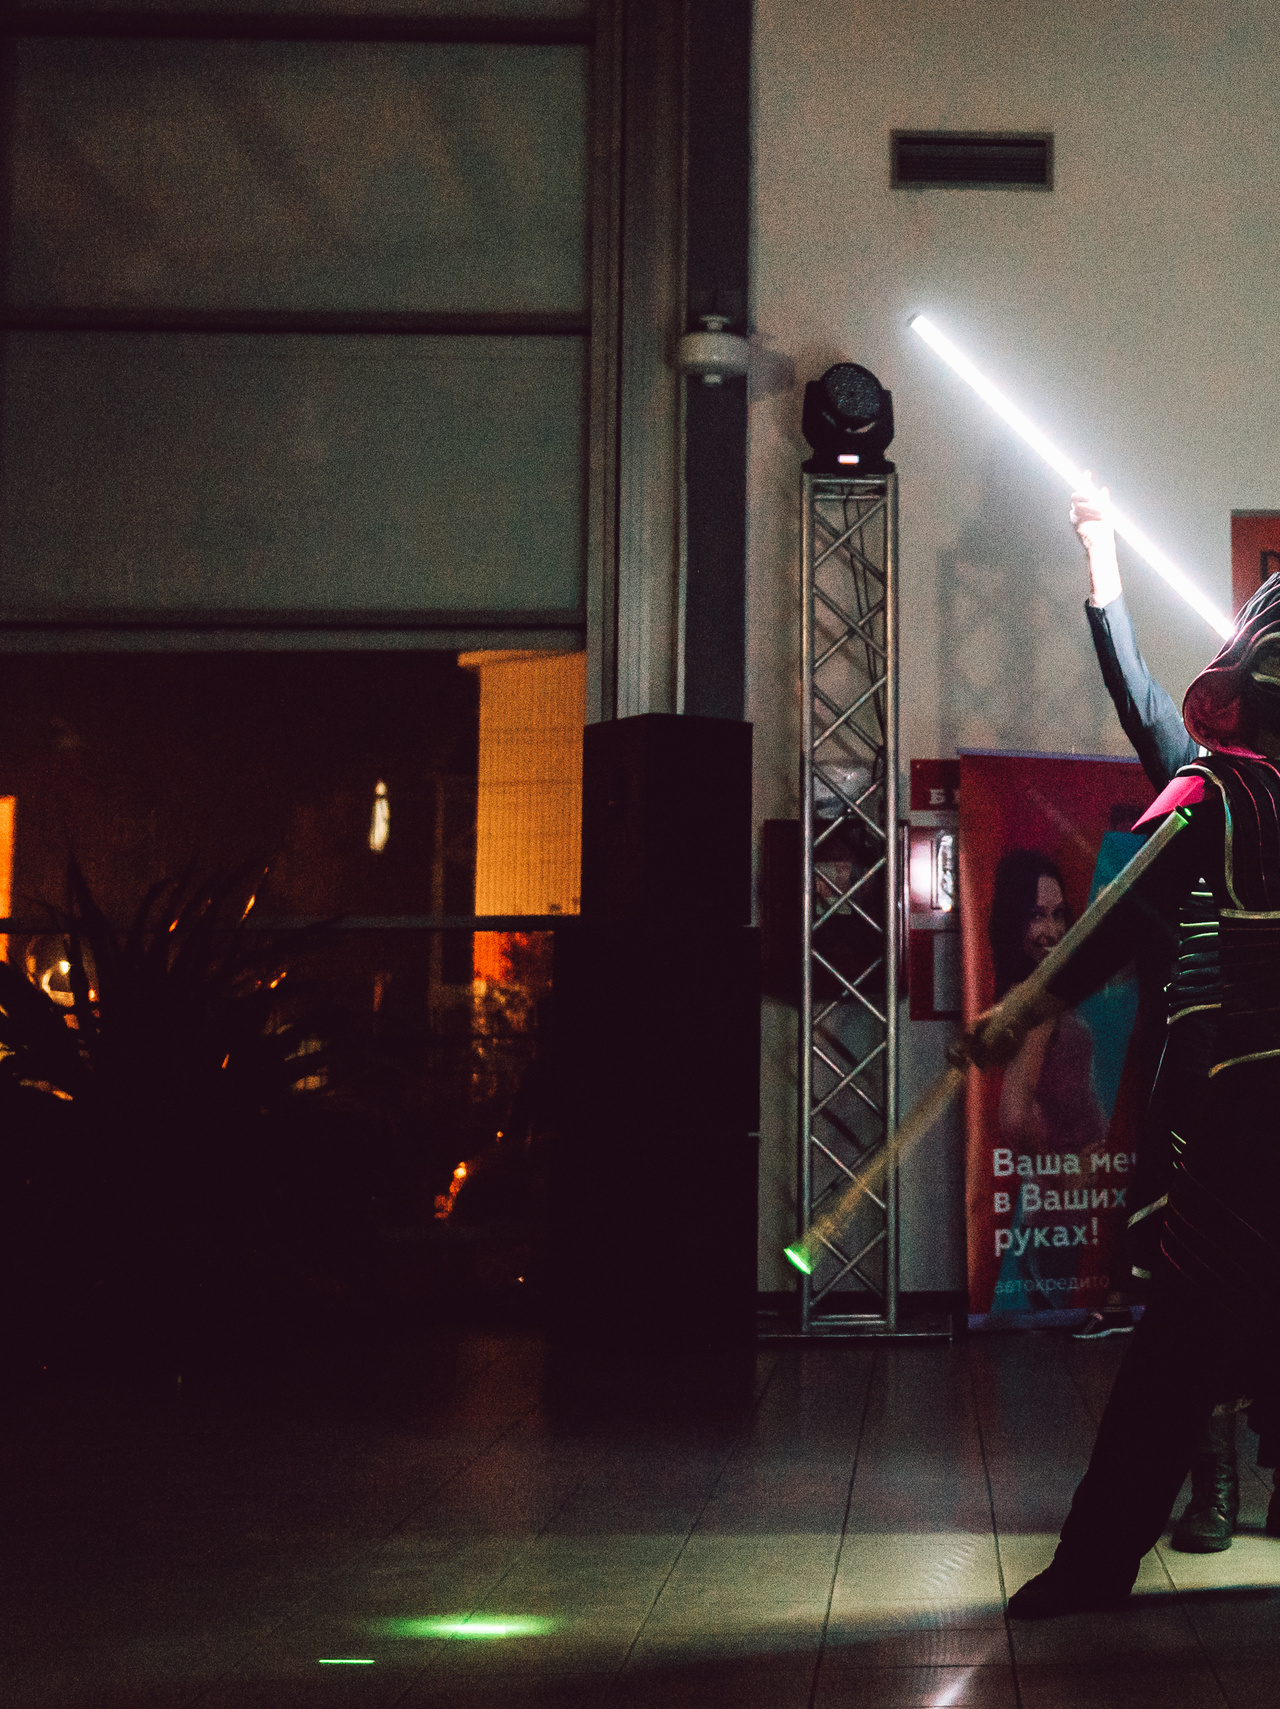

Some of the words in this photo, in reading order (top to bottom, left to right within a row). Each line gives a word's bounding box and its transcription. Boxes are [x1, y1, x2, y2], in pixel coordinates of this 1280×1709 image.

[992, 1147, 1082, 1178] Ваша
[993, 1191, 1012, 1213] в
[1021, 1183, 1128, 1212] Ваших
[994, 1216, 1099, 1258] руках!
[993, 1274, 1110, 1296] автокредито
